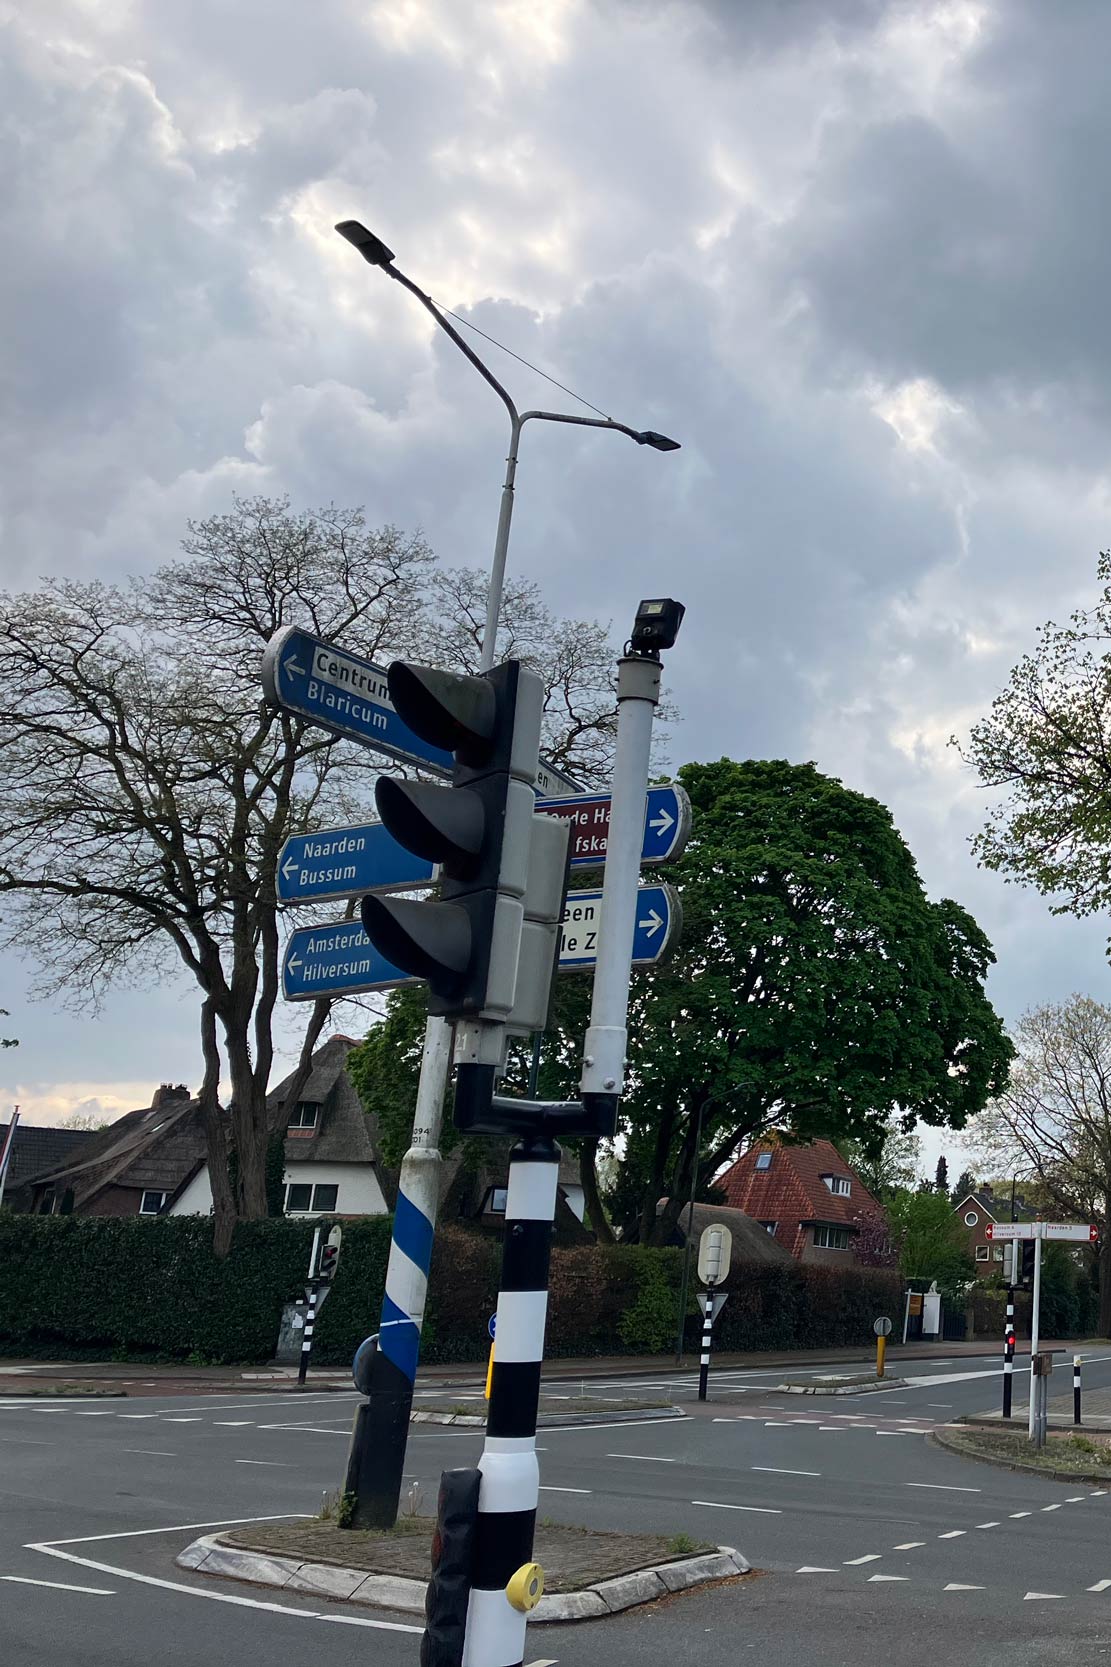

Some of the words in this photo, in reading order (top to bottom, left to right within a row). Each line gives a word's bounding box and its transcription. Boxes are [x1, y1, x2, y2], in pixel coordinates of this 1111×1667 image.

[316, 653, 390, 700] Centrum
[307, 680, 388, 731] Blaricum
[303, 836, 366, 859] Naarden
[299, 865, 357, 886] Bussum
[306, 929, 371, 955] Amsterda
[302, 958, 371, 982] Hilversum
